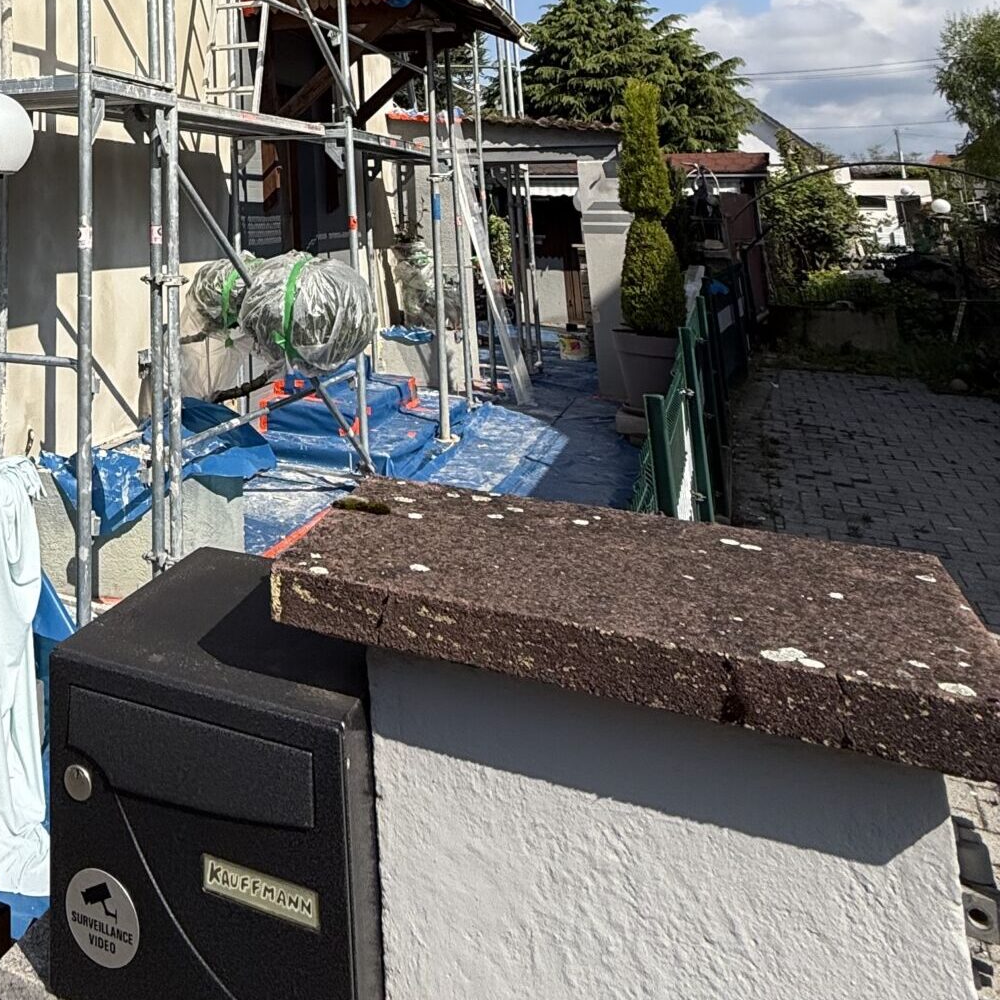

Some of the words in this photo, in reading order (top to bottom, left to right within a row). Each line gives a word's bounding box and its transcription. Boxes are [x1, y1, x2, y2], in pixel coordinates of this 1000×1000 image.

[208, 861, 313, 917] KAUFFMANN
[71, 910, 134, 946] SURVEILLANCE
[88, 932, 116, 954] VIDEO
